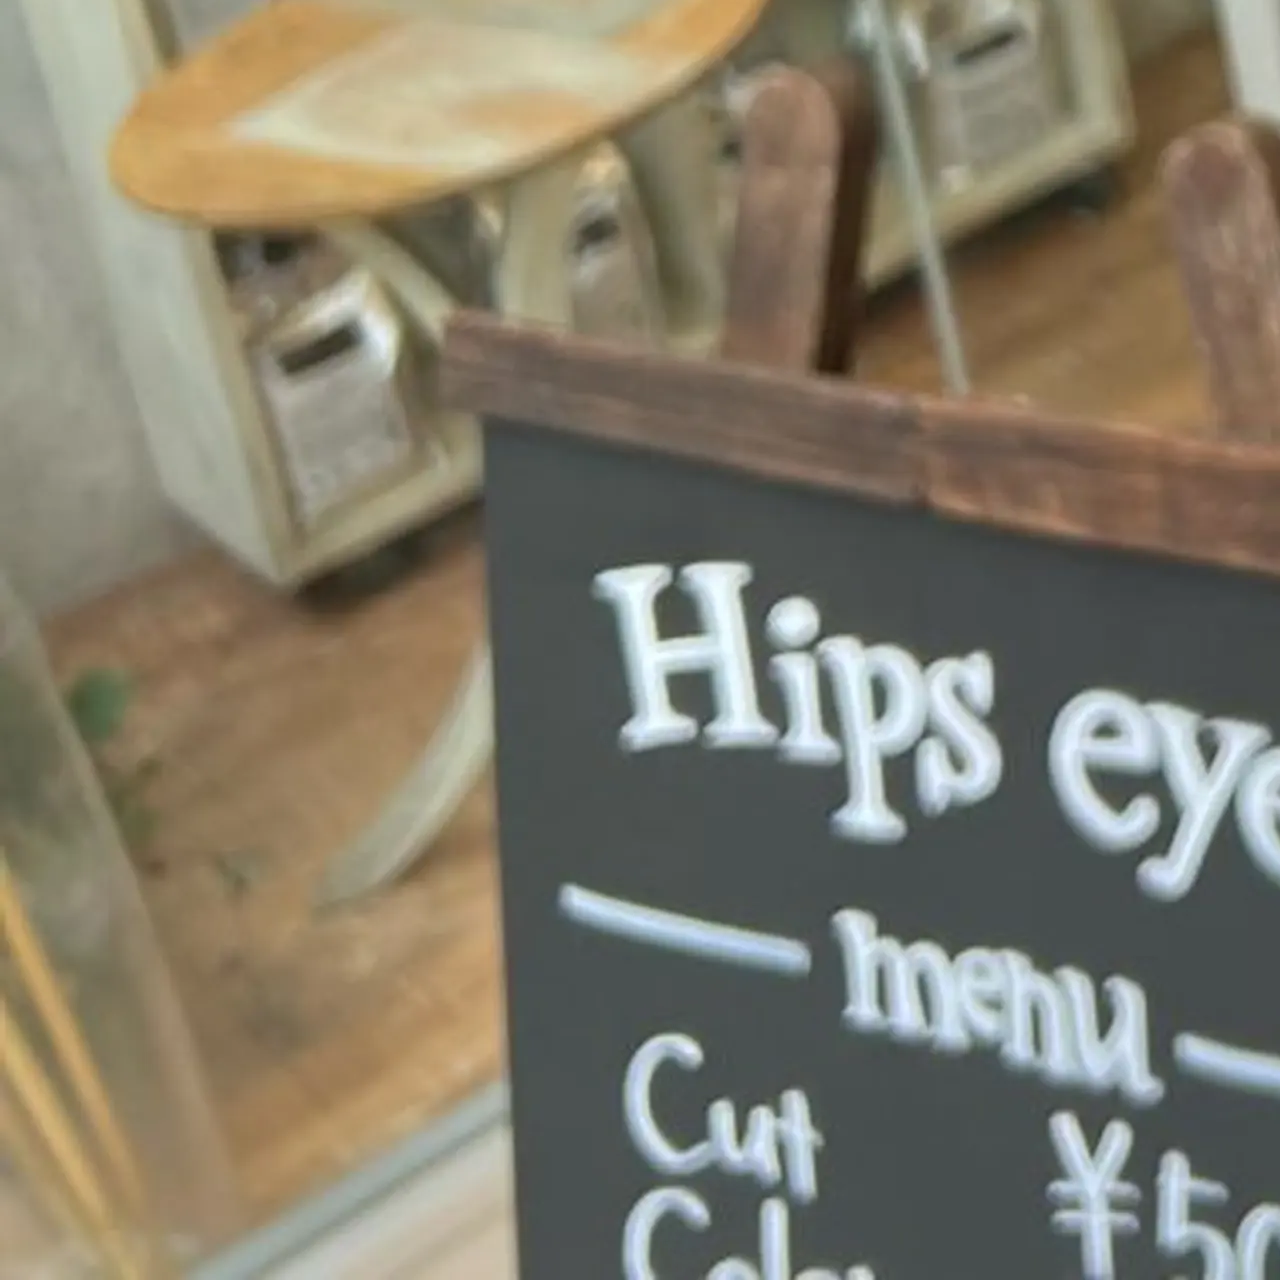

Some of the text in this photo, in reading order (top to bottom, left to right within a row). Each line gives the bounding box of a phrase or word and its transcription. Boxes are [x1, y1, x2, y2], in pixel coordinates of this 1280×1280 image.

[593, 561, 1002, 841] Hips
[832, 907, 1165, 1107] menu
[623, 1032, 823, 1202] Cut
